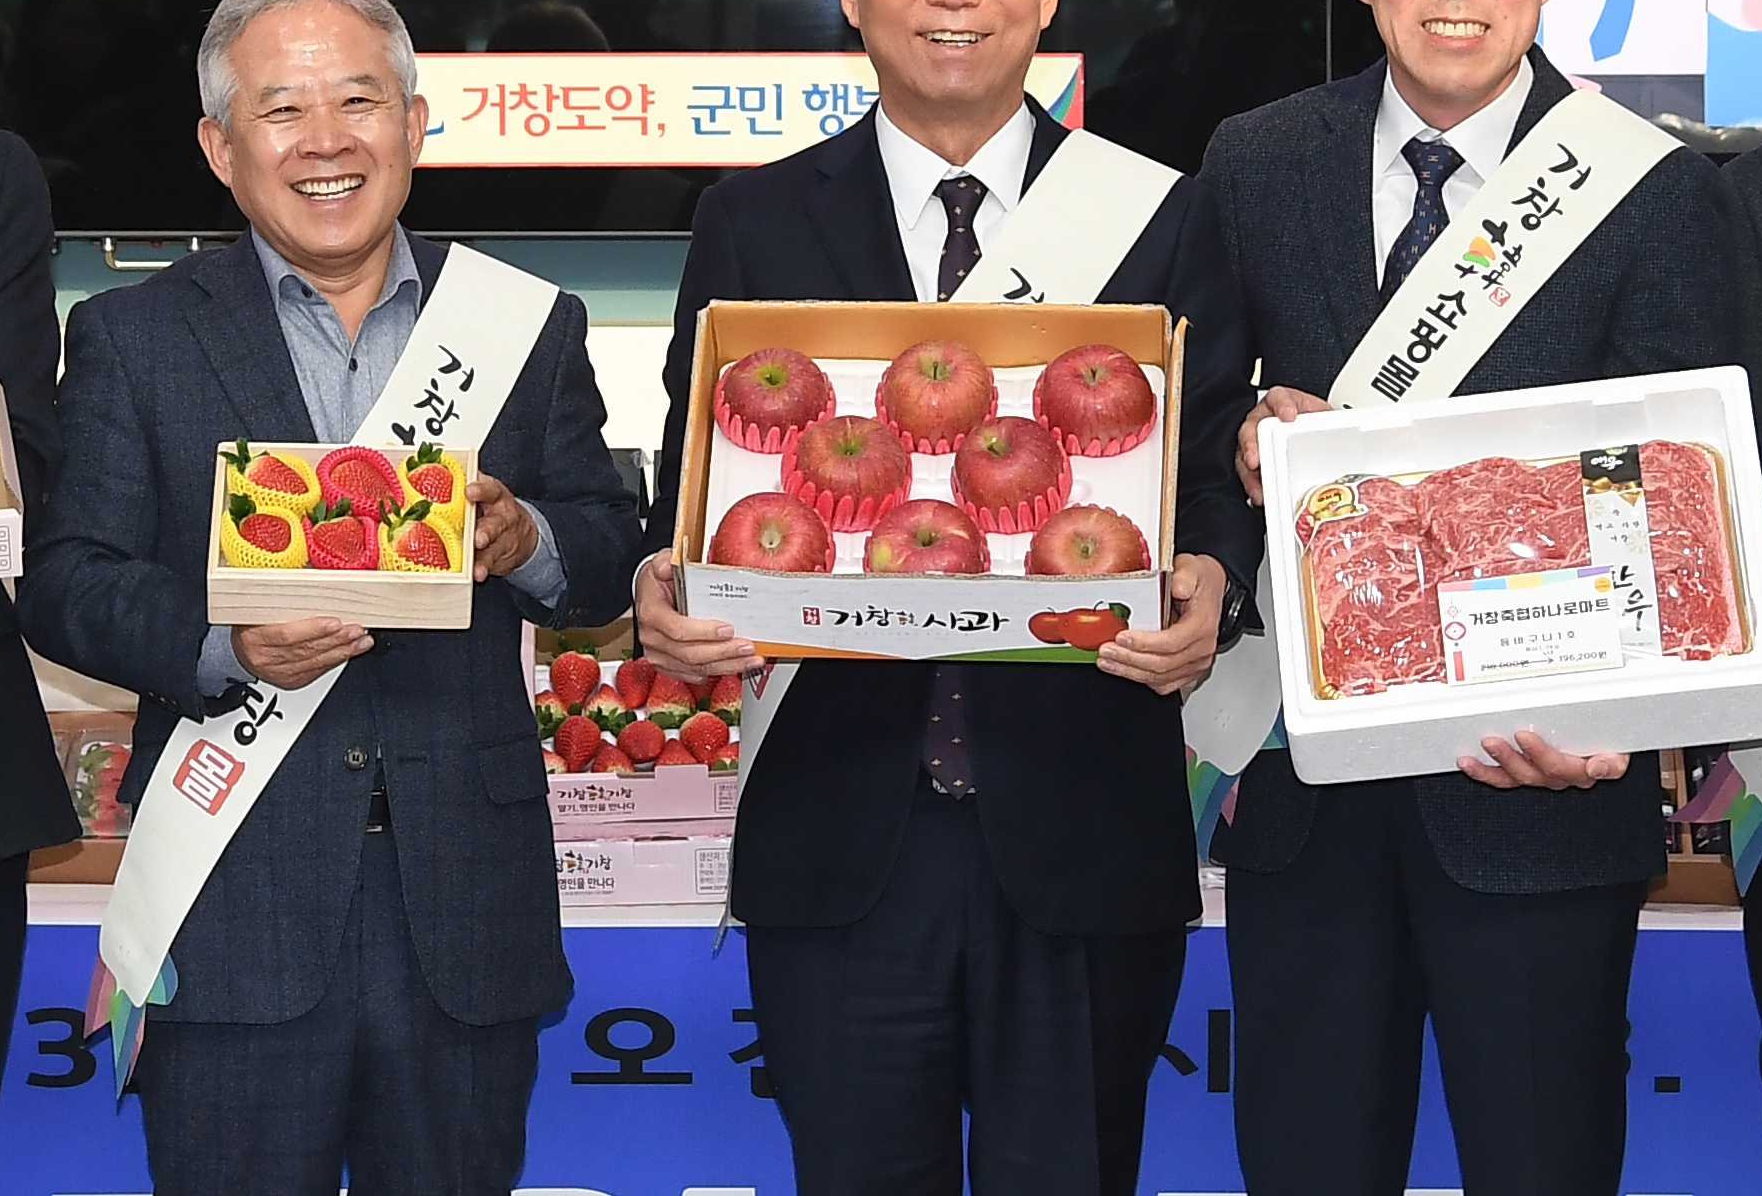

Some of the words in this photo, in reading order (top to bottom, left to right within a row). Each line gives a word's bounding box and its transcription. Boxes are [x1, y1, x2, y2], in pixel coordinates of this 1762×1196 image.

[461, 82, 668, 139] 거창도약,
[687, 83, 785, 136] 군민
[1370, 289, 1469, 403] 쇼핑몰
[1468, 597, 1611, 626] 거창축협하나로마트
[1558, 650, 1608, 663] 196,200원
[607, 801, 636, 812] 만나다
[587, 876, 615, 890] 만나다
